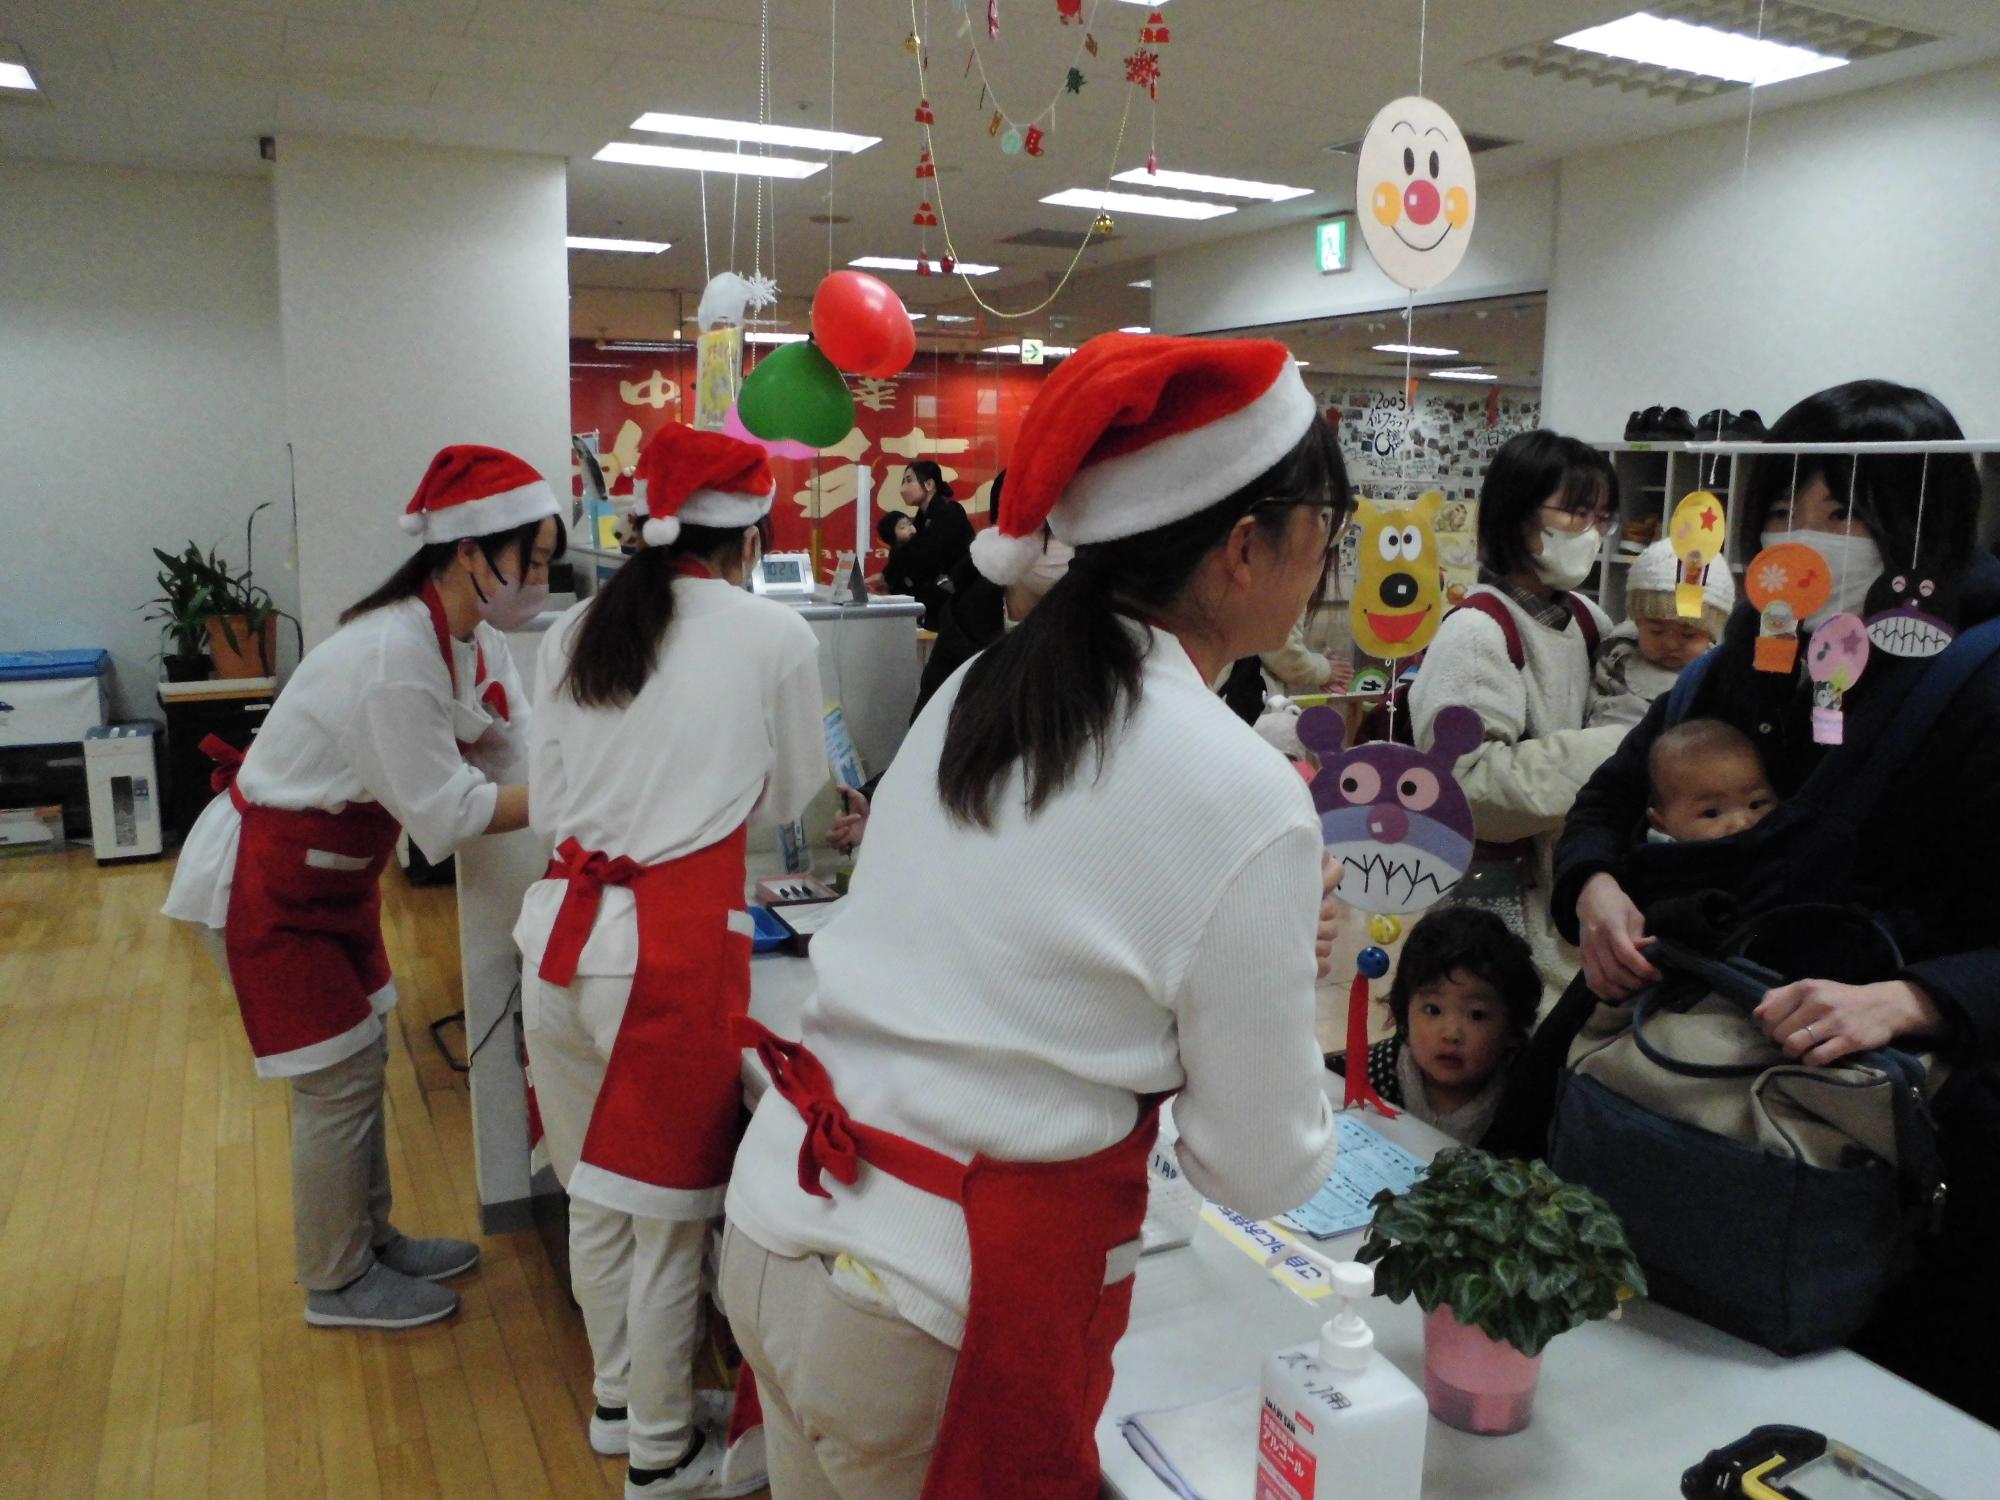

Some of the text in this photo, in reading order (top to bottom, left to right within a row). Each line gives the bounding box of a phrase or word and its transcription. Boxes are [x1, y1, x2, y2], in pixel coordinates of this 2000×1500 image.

[1262, 1424, 1305, 1478] アルコール
